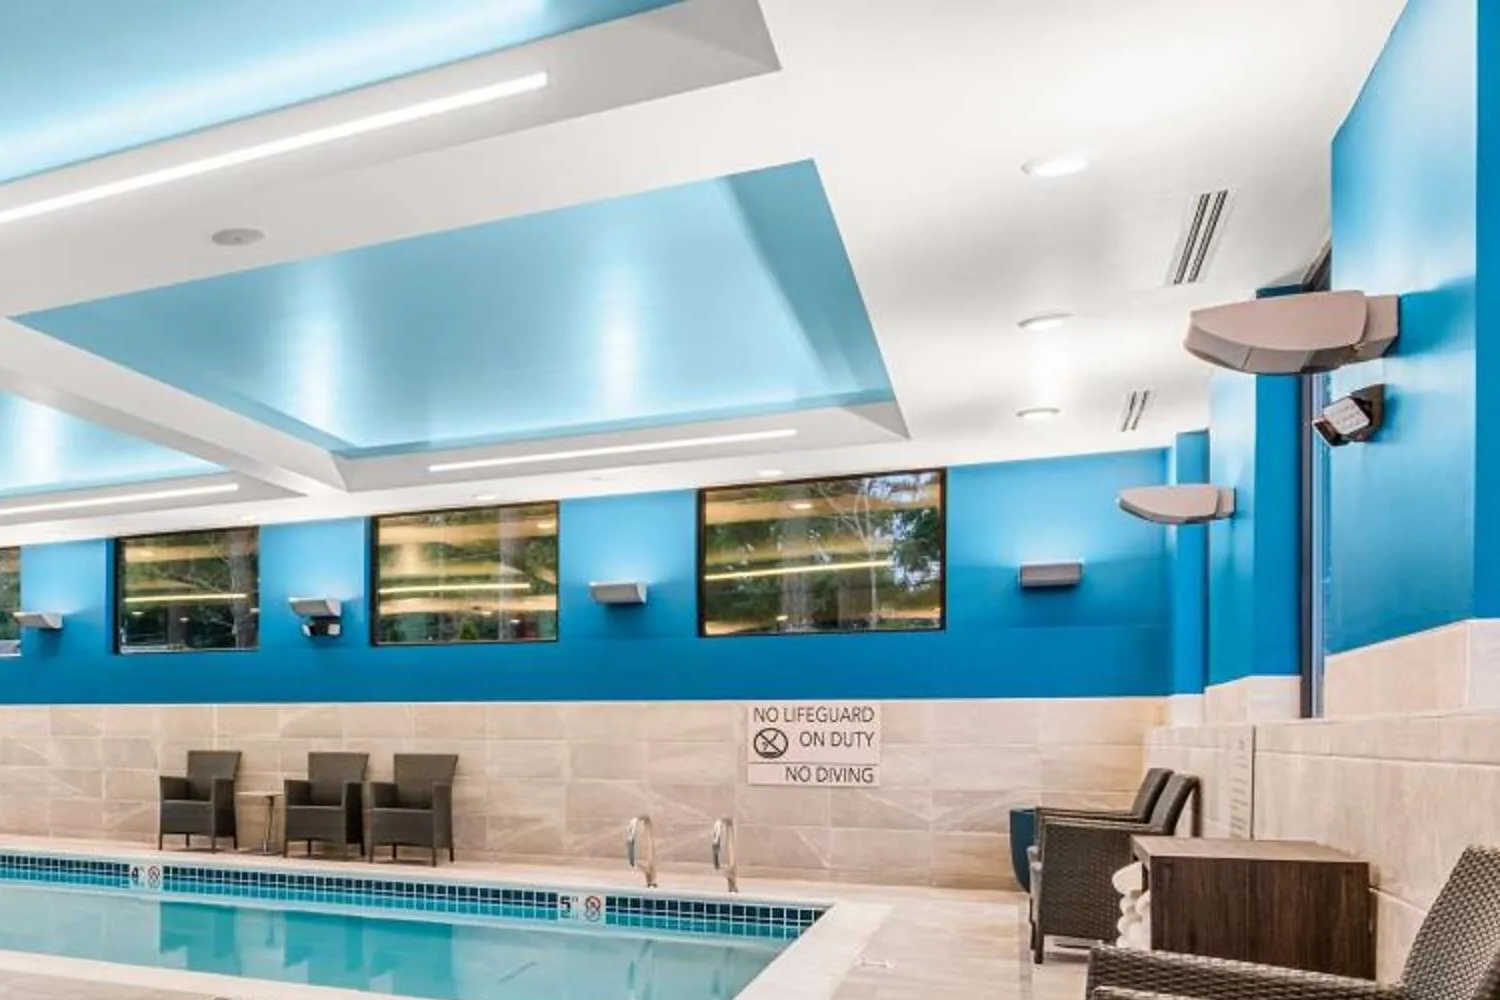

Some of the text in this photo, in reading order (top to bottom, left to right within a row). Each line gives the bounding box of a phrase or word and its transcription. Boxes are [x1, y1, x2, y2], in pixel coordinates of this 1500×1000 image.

[753, 706, 875, 723] NO LIFEGUARD
[799, 731, 875, 747] ON DUTY
[786, 766, 874, 783] NO DIVING
